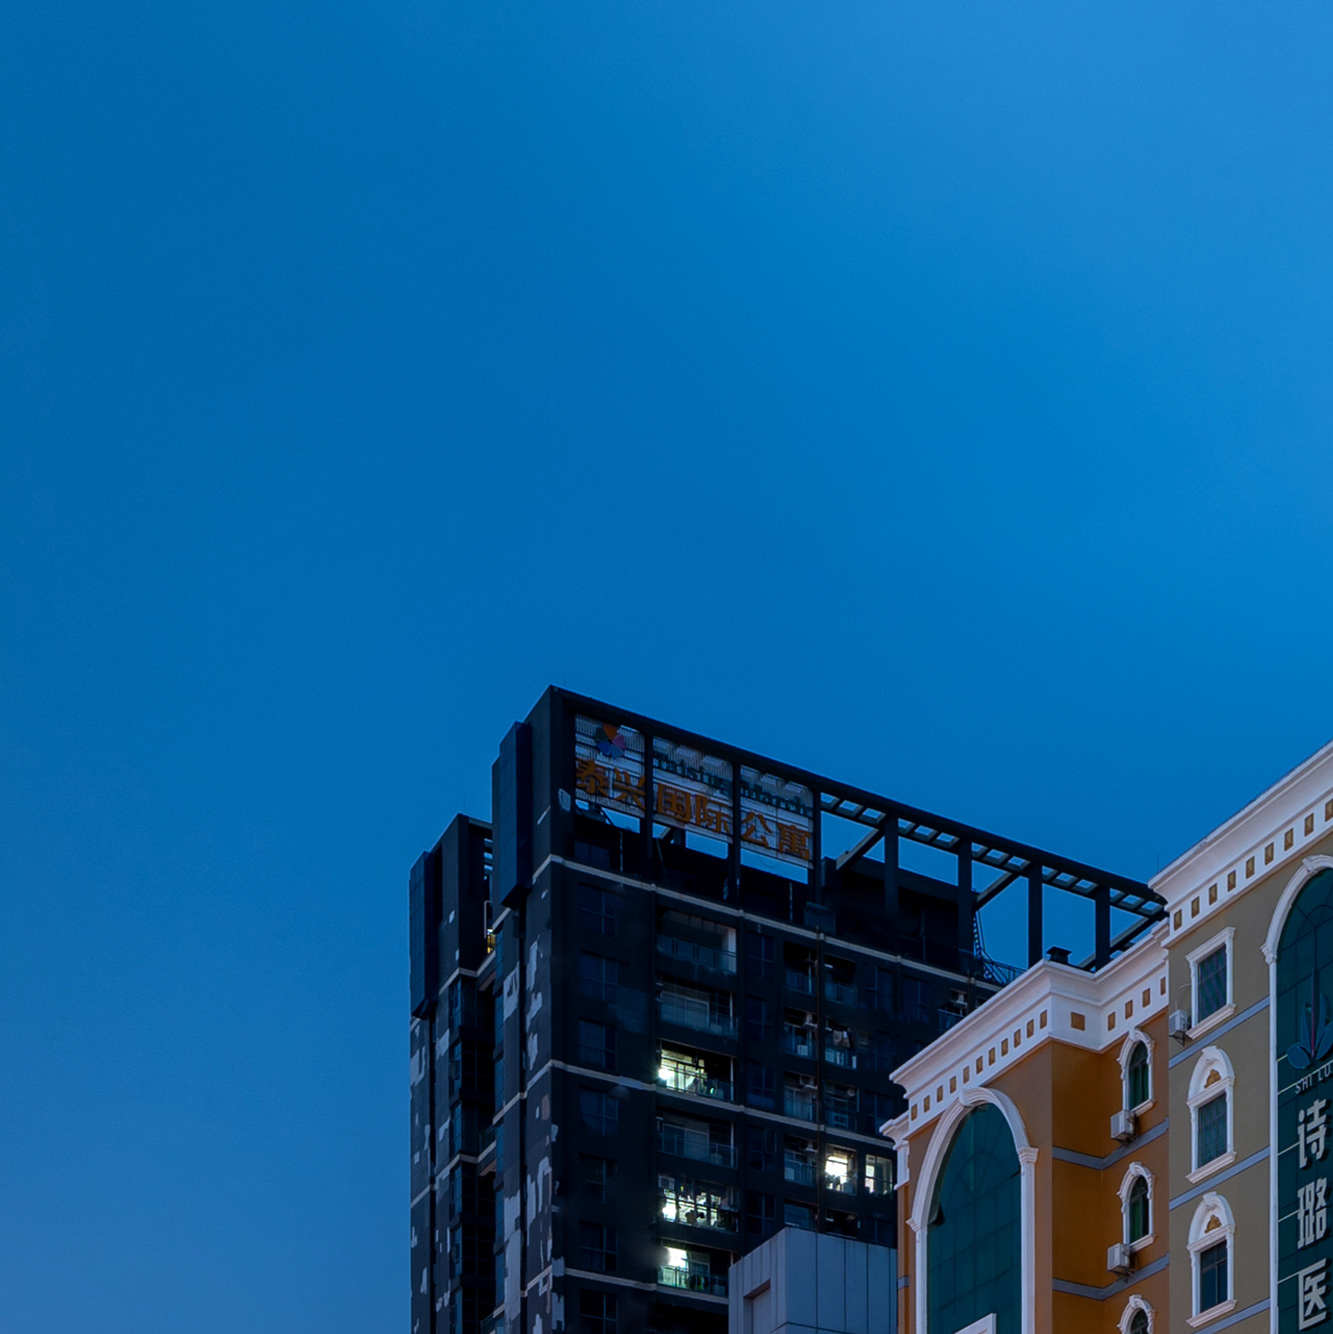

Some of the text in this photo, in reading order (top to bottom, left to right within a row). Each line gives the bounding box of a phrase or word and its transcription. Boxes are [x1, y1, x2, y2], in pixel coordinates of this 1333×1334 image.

[575, 756, 811, 862] 泰兴国际公寓
